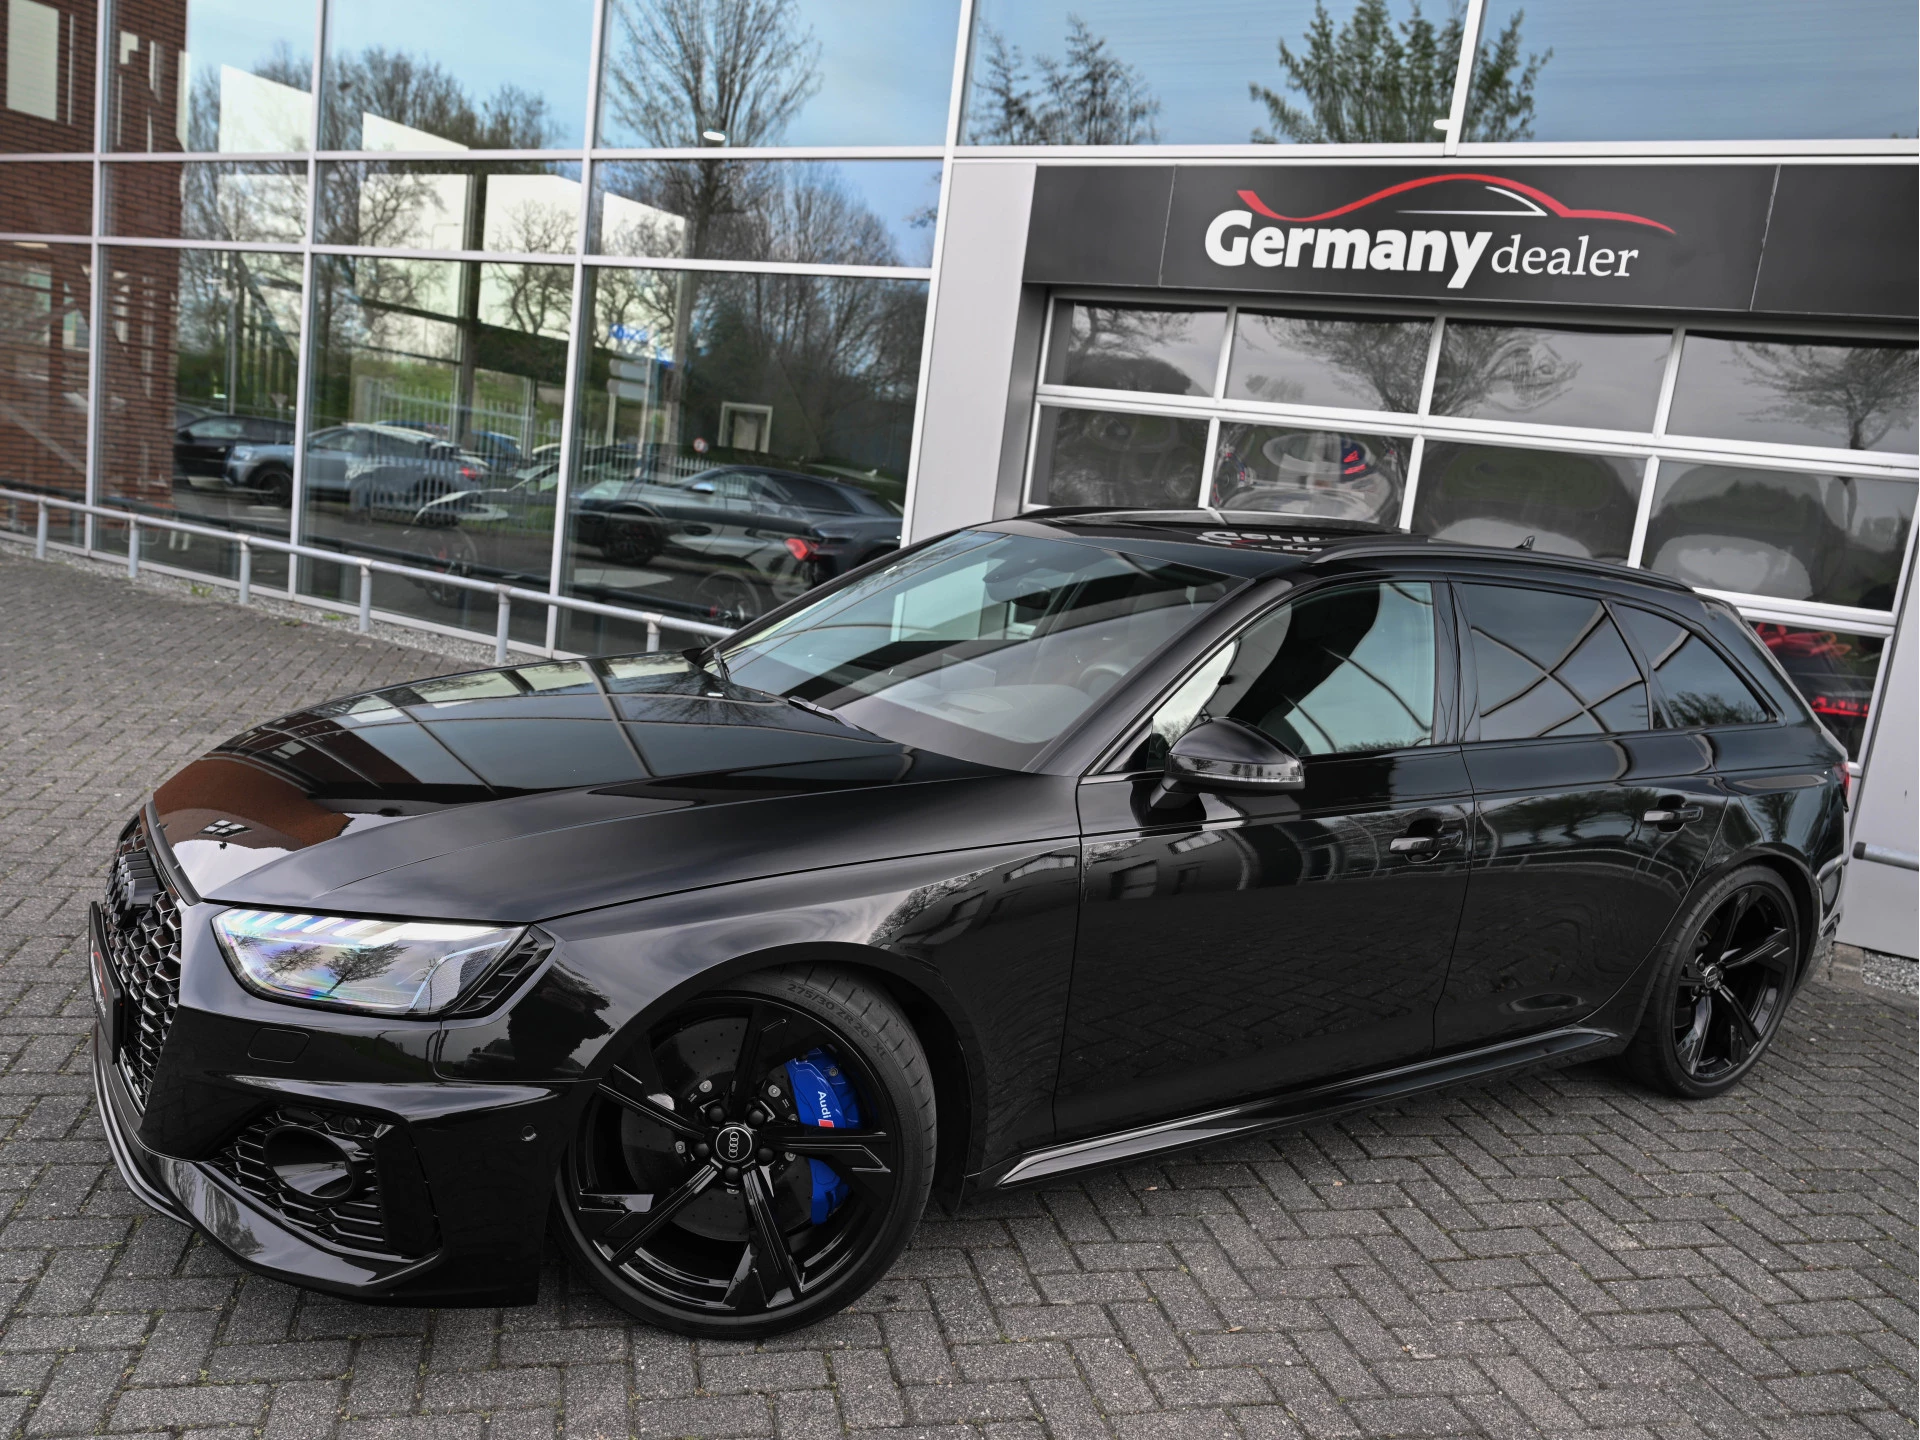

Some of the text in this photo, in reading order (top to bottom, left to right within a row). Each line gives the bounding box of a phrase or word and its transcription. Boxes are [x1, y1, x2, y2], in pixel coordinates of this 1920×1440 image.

[1204, 209, 1639, 289] Germany dealer
[787, 983, 835, 1011] 275/30
[836, 1010, 854, 1025] ZR
[854, 1022, 870, 1038] 20
[872, 1042, 887, 1060] XL
[817, 1090, 832, 1119] Audi
